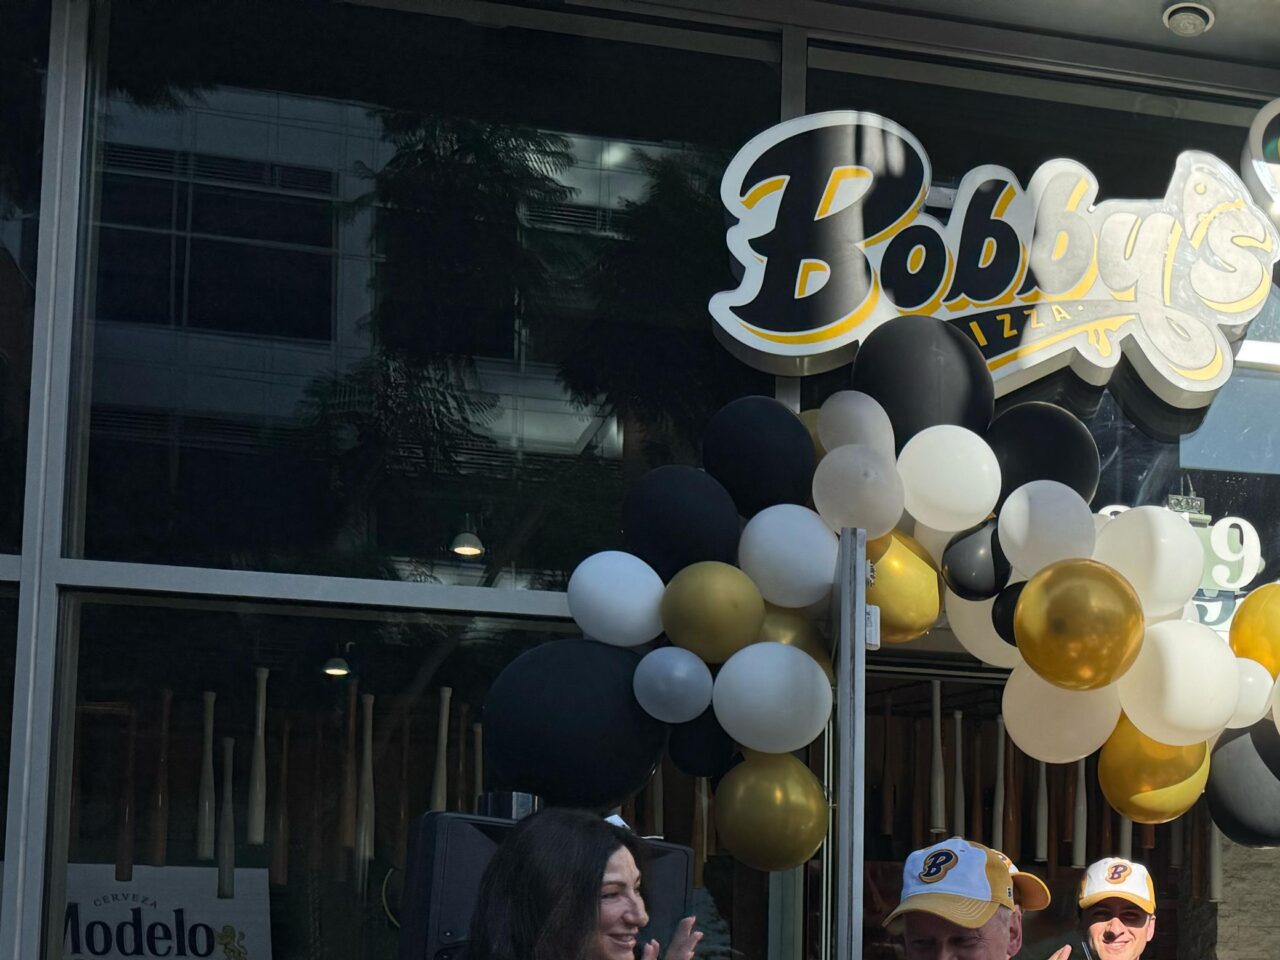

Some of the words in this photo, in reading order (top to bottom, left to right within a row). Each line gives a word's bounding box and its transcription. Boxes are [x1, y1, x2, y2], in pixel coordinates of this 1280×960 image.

[724, 113, 1274, 386] Bobby's
[969, 304, 1071, 347] IZZA
[921, 849, 957, 880] B
[1105, 863, 1130, 882] B
[94, 893, 157, 909] CERVEZA
